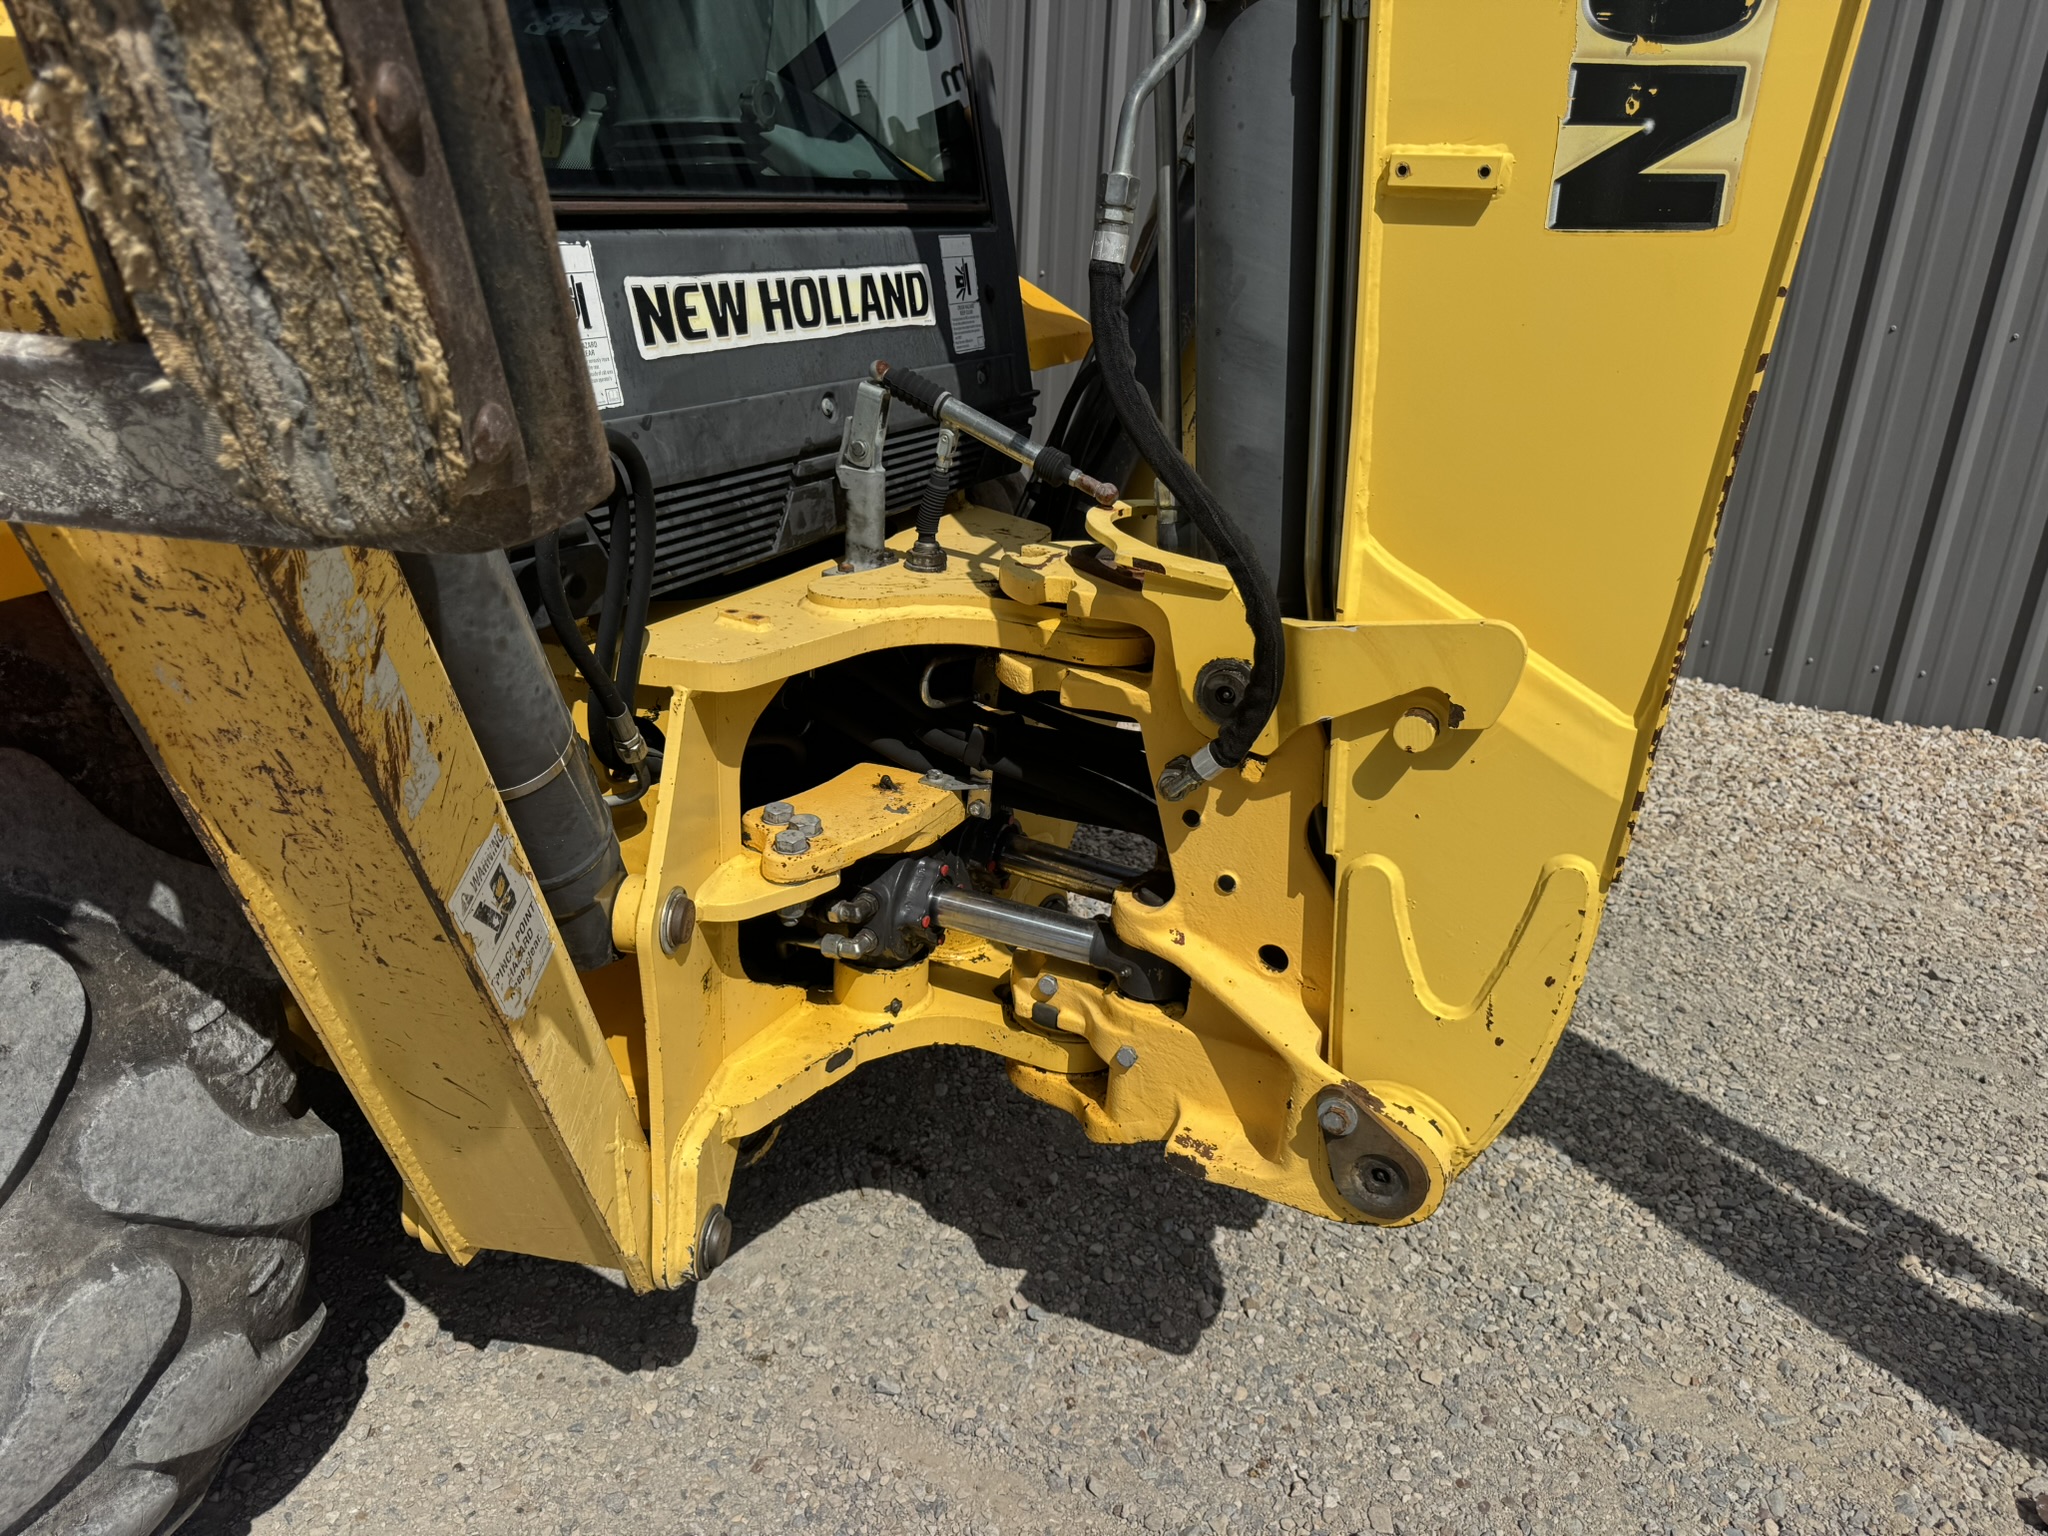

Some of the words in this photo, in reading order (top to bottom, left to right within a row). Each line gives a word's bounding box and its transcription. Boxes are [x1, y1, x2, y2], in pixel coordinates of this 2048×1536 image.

[631, 280, 749, 347] NEW
[756, 270, 930, 333] HOLLAND
[493, 941, 516, 986] PINCH
[515, 901, 536, 943] POINT
